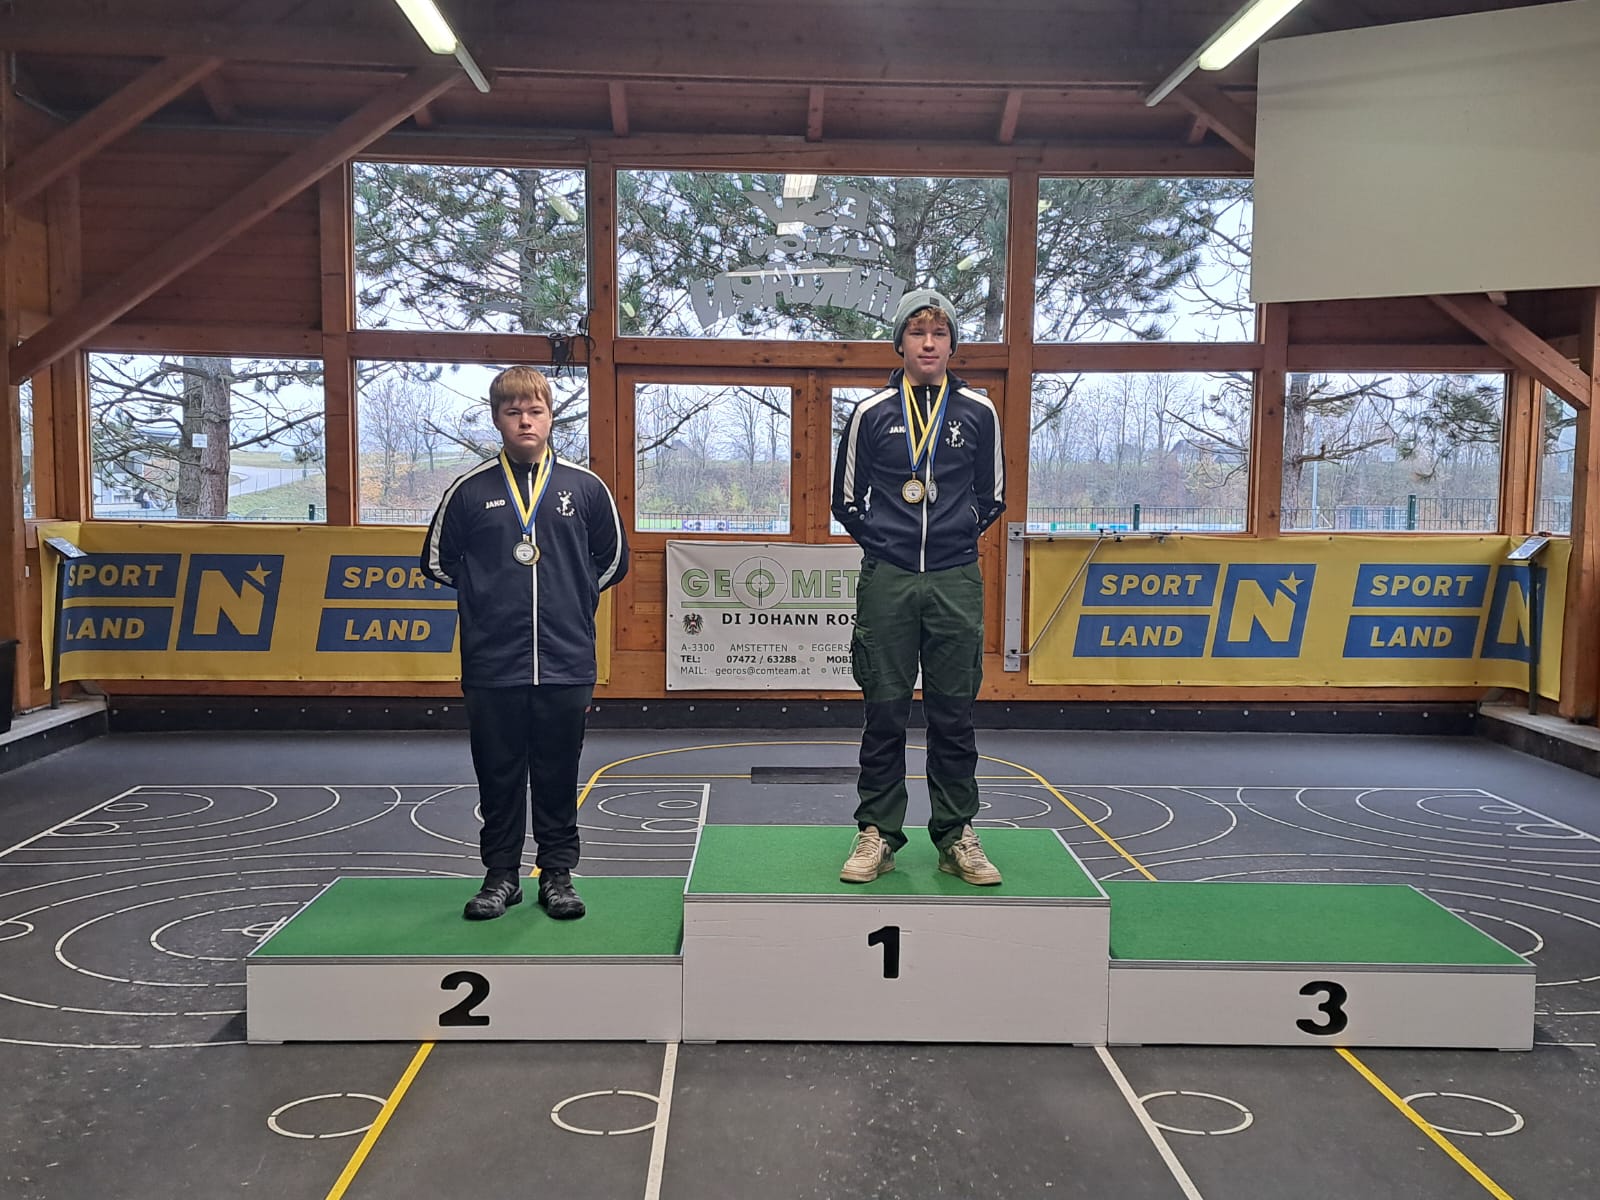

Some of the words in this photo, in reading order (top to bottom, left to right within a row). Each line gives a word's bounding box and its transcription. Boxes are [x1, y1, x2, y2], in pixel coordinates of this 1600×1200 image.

[485, 499, 505, 509] JAKO
[68, 564, 163, 586] SPORT
[342, 567, 442, 589] SPOR
[1099, 574, 1202, 596] SPORT
[1370, 575, 1473, 597] SPORT
[67, 618, 145, 640] LAND
[344, 619, 432, 641] LAND
[722, 613, 742, 625] DI
[748, 613, 818, 626] JOHANN
[1100, 625, 1183, 647] LAND
[1371, 626, 1454, 648] LAND
[681, 643, 715, 652] A-3300
[730, 643, 788, 652] AMSTETTEN
[680, 655, 701, 664] TEL:
[726, 655, 756, 664] 07472
[767, 655, 797, 664] 63288
[681, 667, 707, 675] MAIL:
[715, 667, 810, 676] georos@comteam.at
[867, 925, 900, 979] 1
[438, 970, 491, 1028] 2
[1296, 980, 1349, 1035] 3
